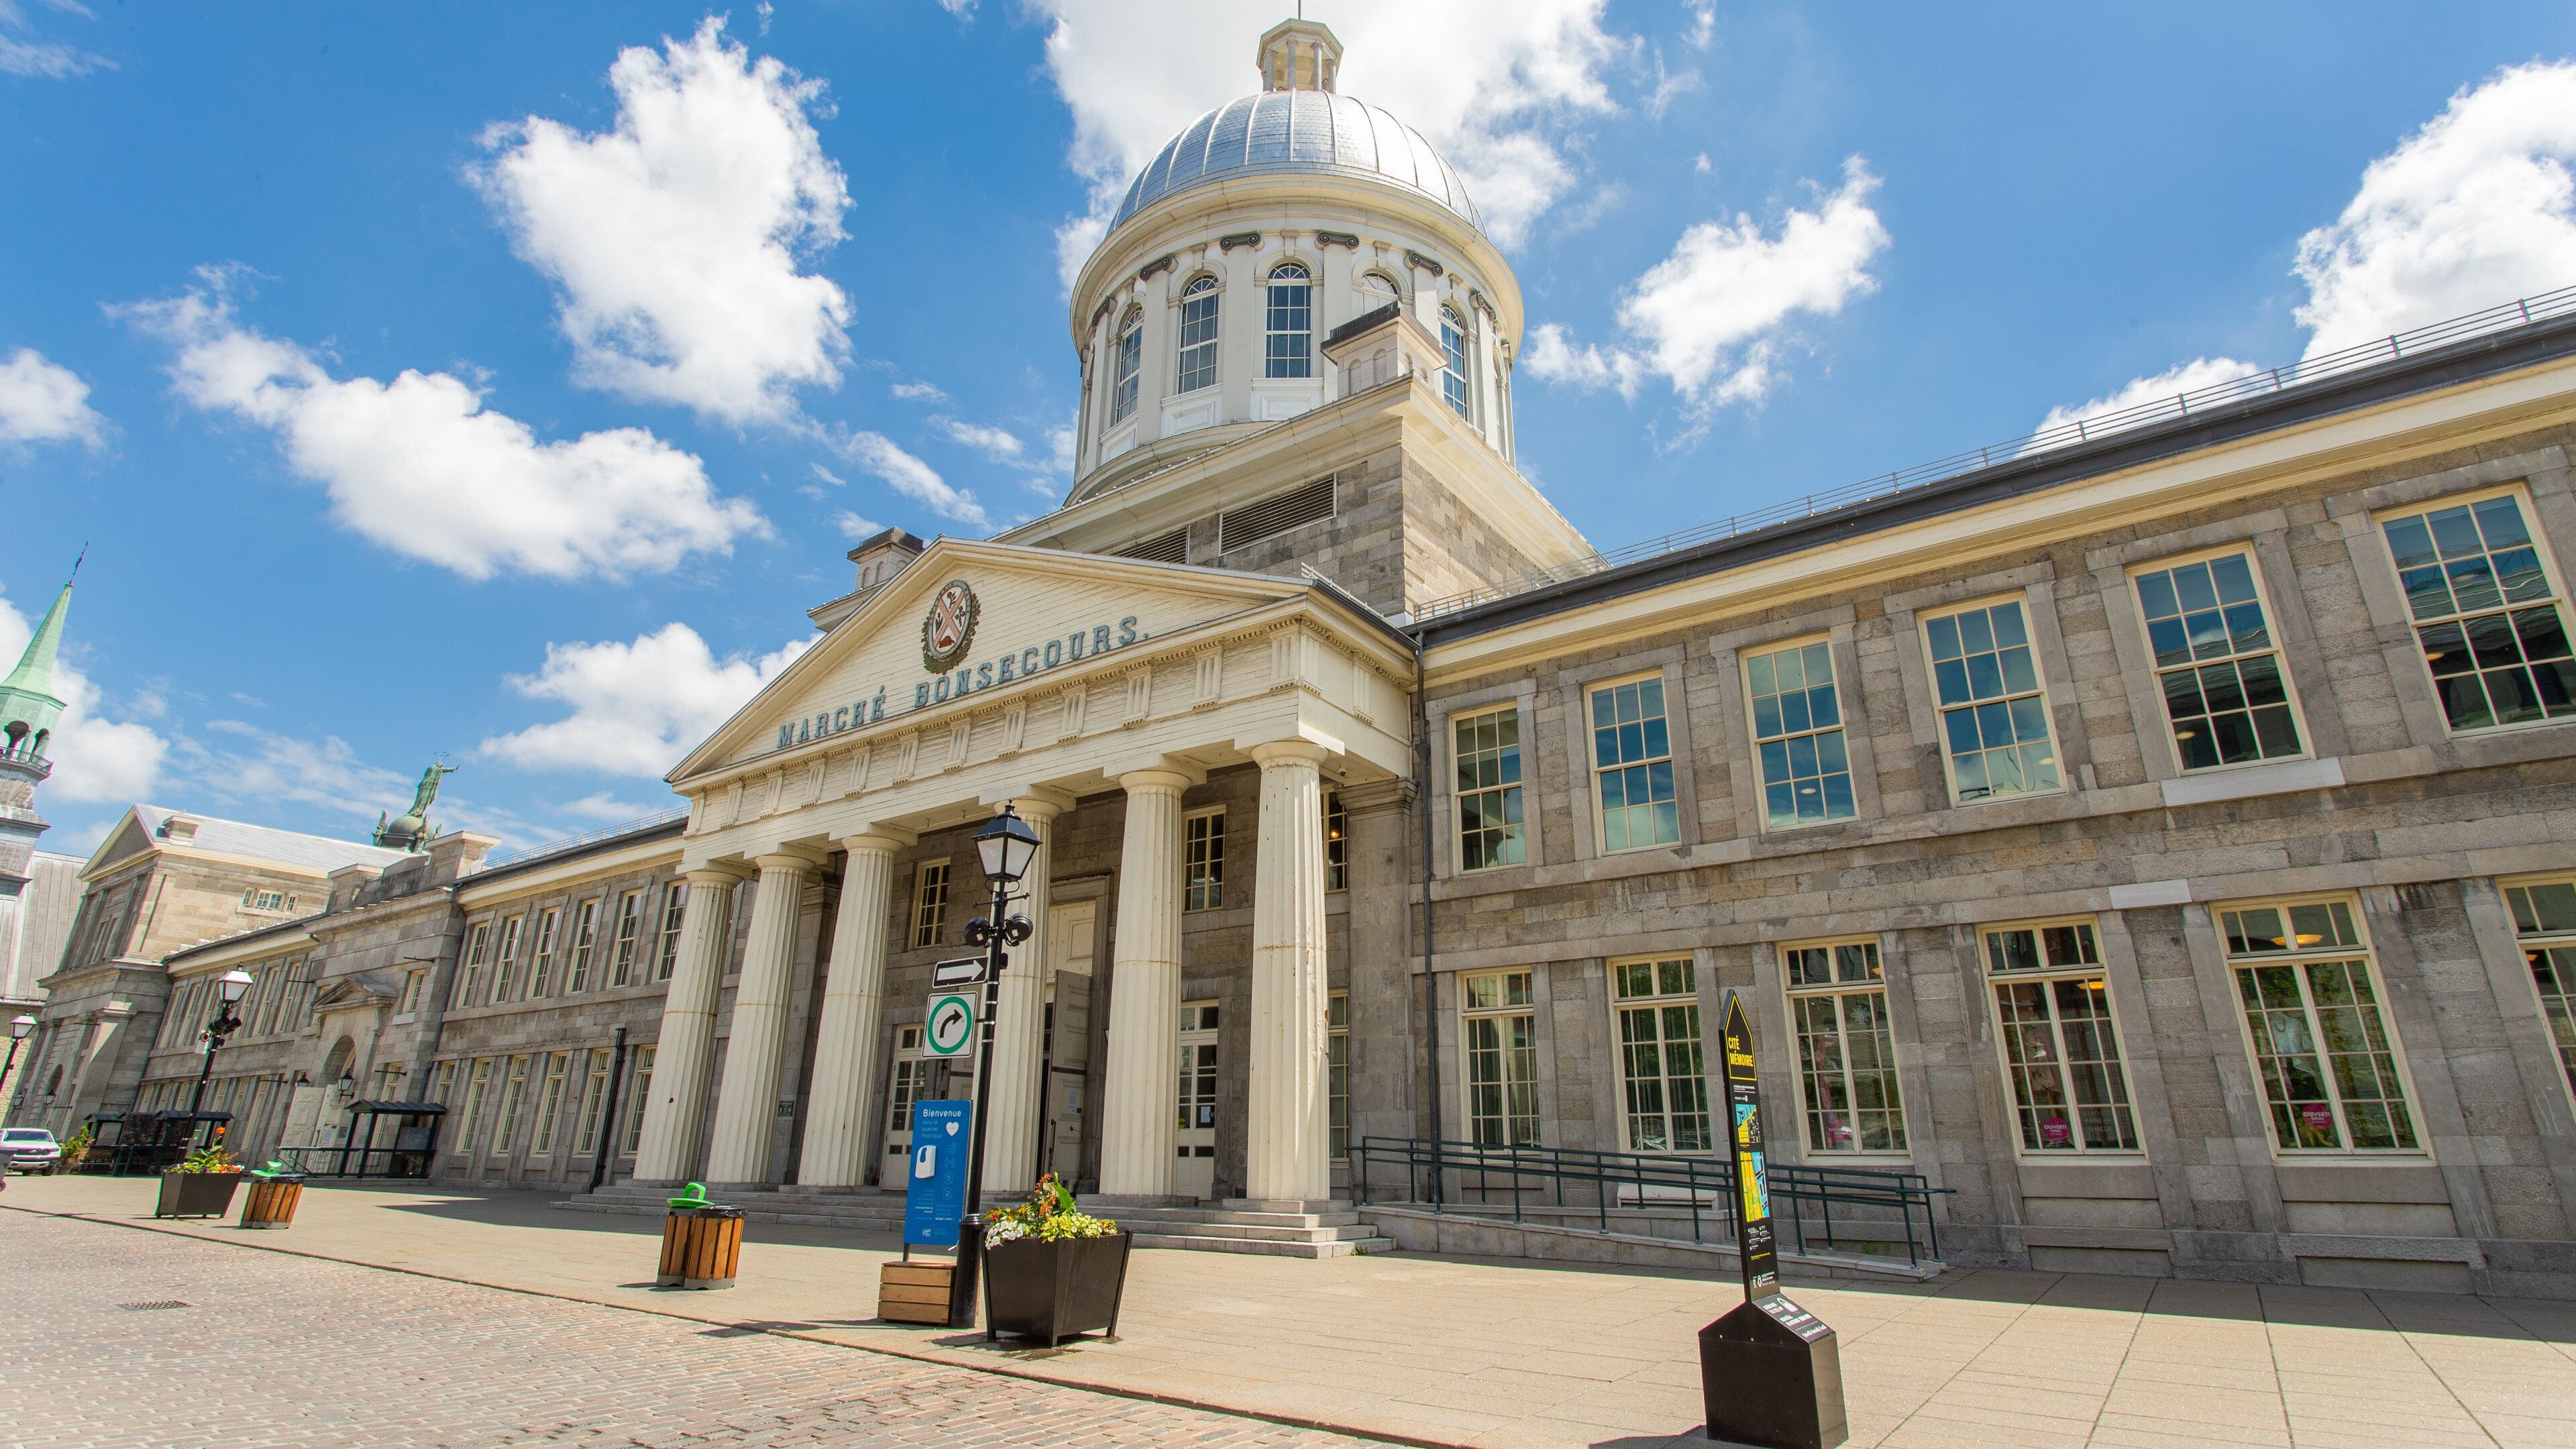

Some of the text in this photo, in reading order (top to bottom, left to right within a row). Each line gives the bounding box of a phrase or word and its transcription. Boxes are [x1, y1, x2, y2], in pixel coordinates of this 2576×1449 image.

[777, 615, 1148, 749] MARCHÉ BONSECOURS.
[1728, 1034, 1740, 1050] CITÉ
[1729, 1050, 1754, 1067] MÉMOIRE
[923, 1109, 961, 1117] Bienvenue
